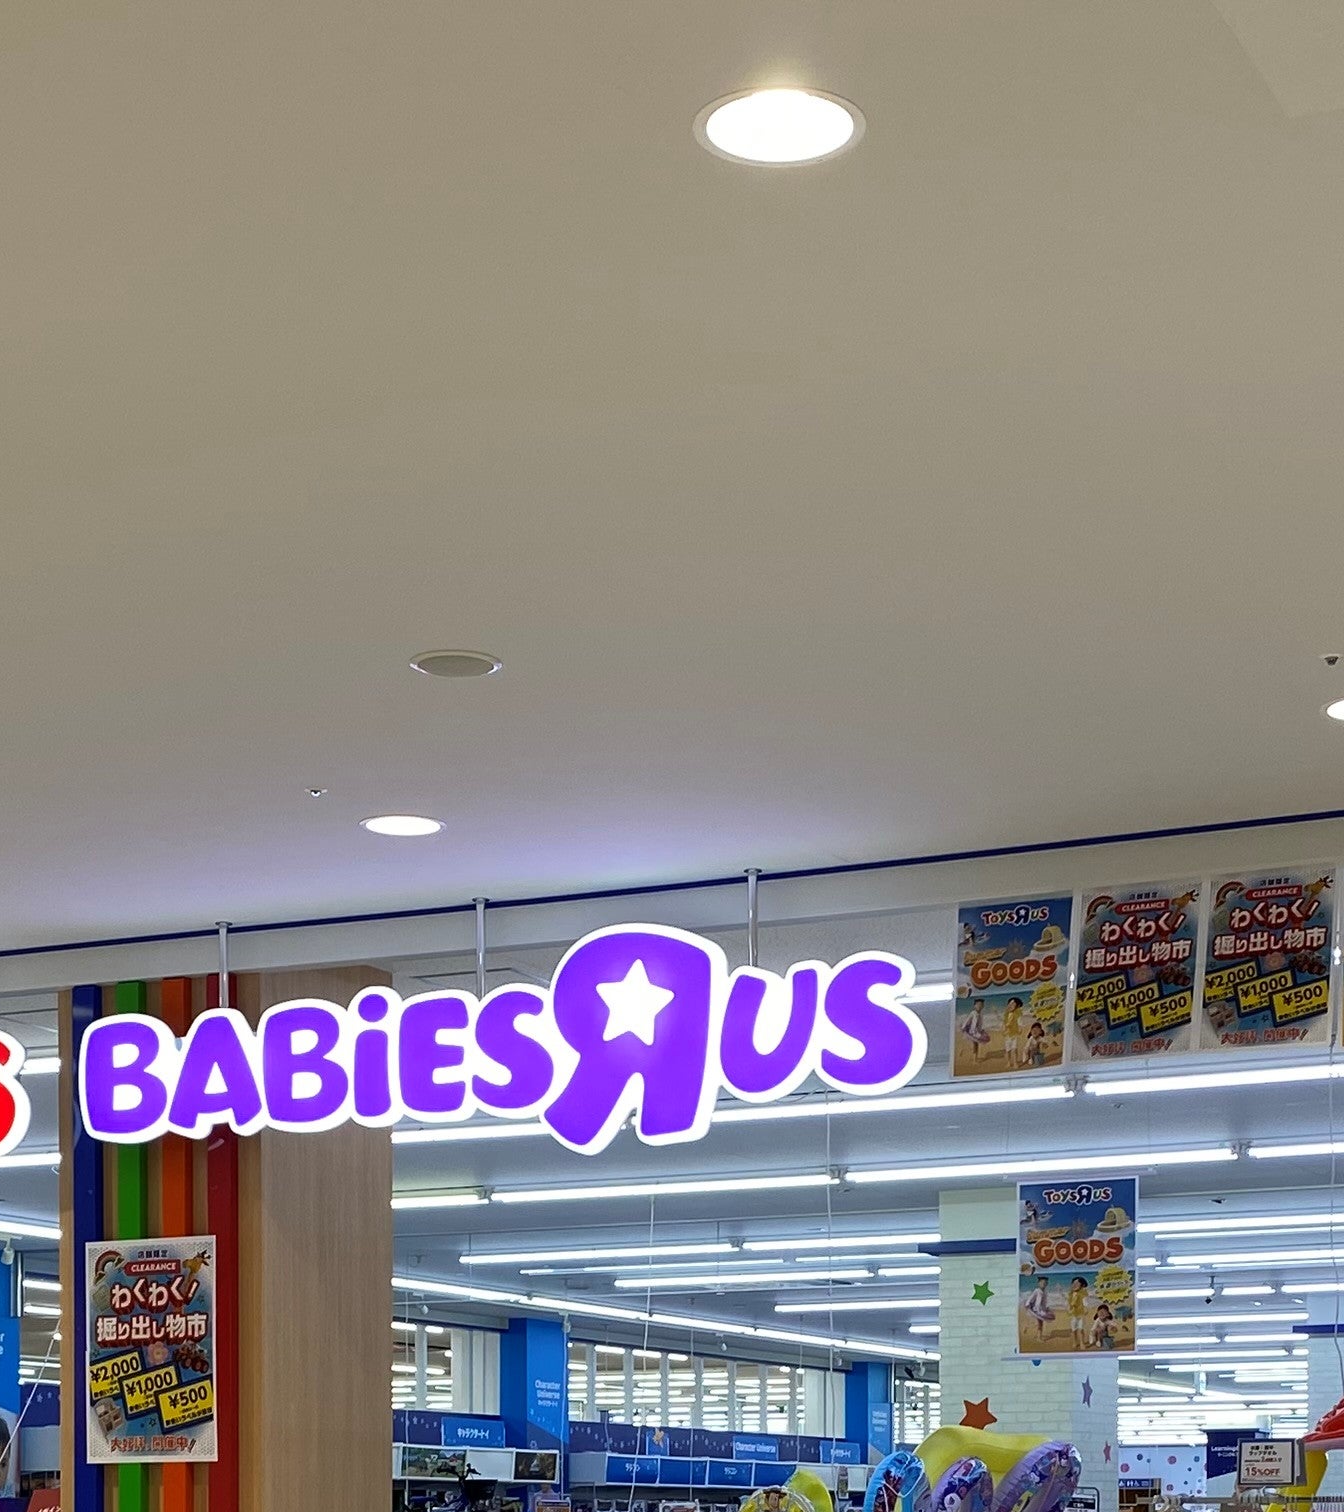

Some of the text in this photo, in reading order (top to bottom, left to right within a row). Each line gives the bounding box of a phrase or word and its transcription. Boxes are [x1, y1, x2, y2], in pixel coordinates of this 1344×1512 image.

[1253, 888, 1298, 897] CLEARANCE
[1122, 901, 1165, 912] CLEARANCE
[1214, 927, 1327, 955] 掘り出し物市
[1085, 939, 1191, 968] 掘り出し物市
[970, 955, 1057, 989] GOODS
[1150, 996, 1187, 1016] ¥500
[1283, 985, 1323, 1006] ¥500
[1034, 1237, 1124, 1267] GOODS
[131, 1263, 176, 1273] CLEARANCE
[96, 1314, 208, 1343] 掘り出し物市
[91, 1357, 140, 1383] ¥2,000
[125, 1371, 174, 1397] ¥1,000
[168, 1386, 208, 1409] ¥500
[1245, 1467, 1280, 1476] 15%OFF
